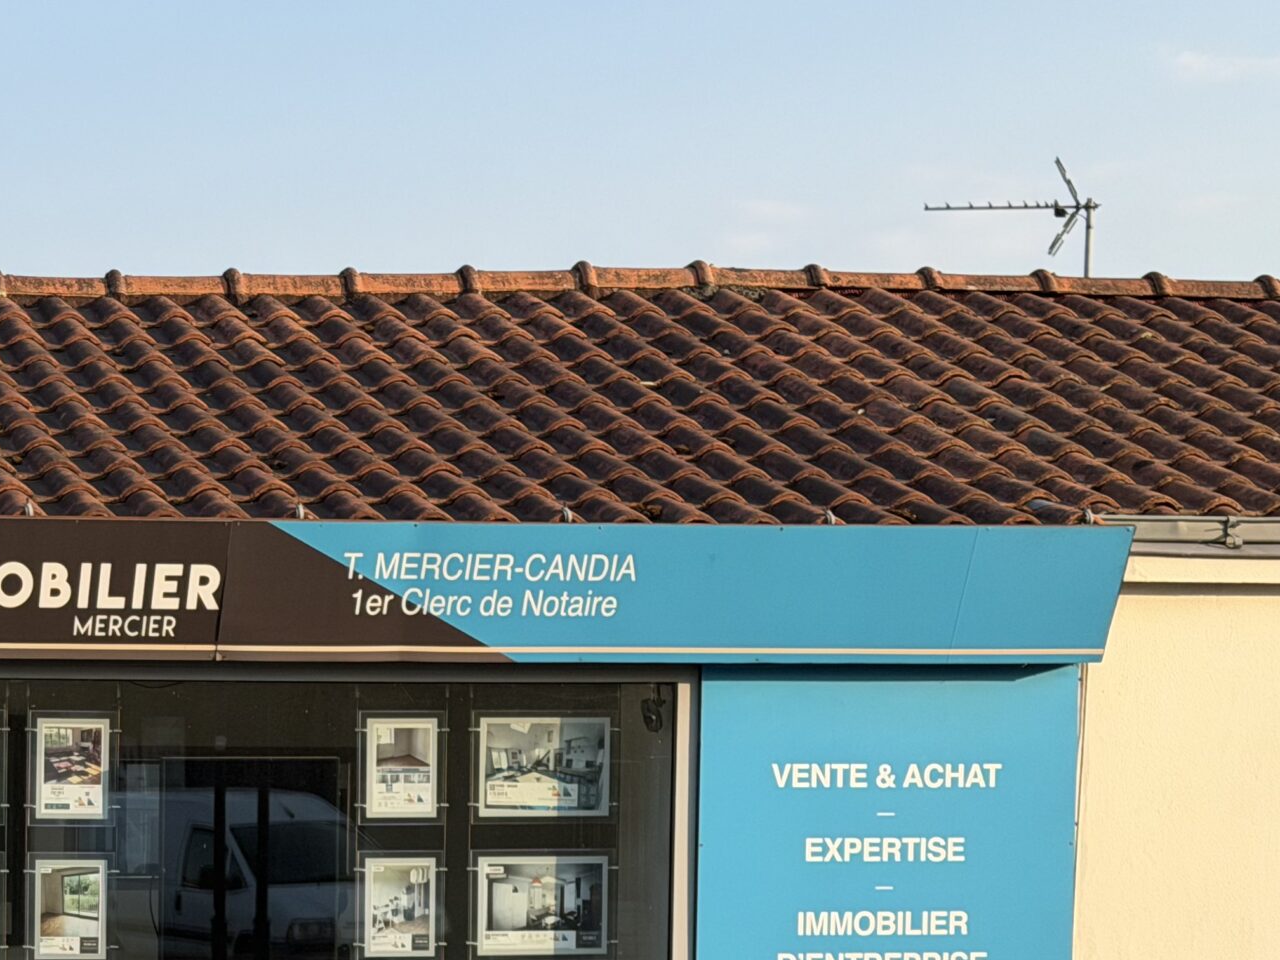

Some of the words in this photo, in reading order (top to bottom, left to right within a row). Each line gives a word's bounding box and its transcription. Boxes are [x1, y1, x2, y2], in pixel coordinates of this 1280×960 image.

[344, 552, 365, 580] T.
[374, 552, 637, 582] MERCIER-CANDIA
[351, 588, 395, 616] 1er
[401, 587, 472, 617] Clerc
[479, 588, 513, 617] de
[521, 589, 618, 618] Notaire
[73, 615, 177, 638] MERCIER
[771, 763, 868, 789] VENTE
[875, 763, 897, 789] &
[902, 763, 1003, 789] ACHAT
[805, 837, 966, 862] EXPERTISE
[797, 910, 968, 936] IMMOBILIER
